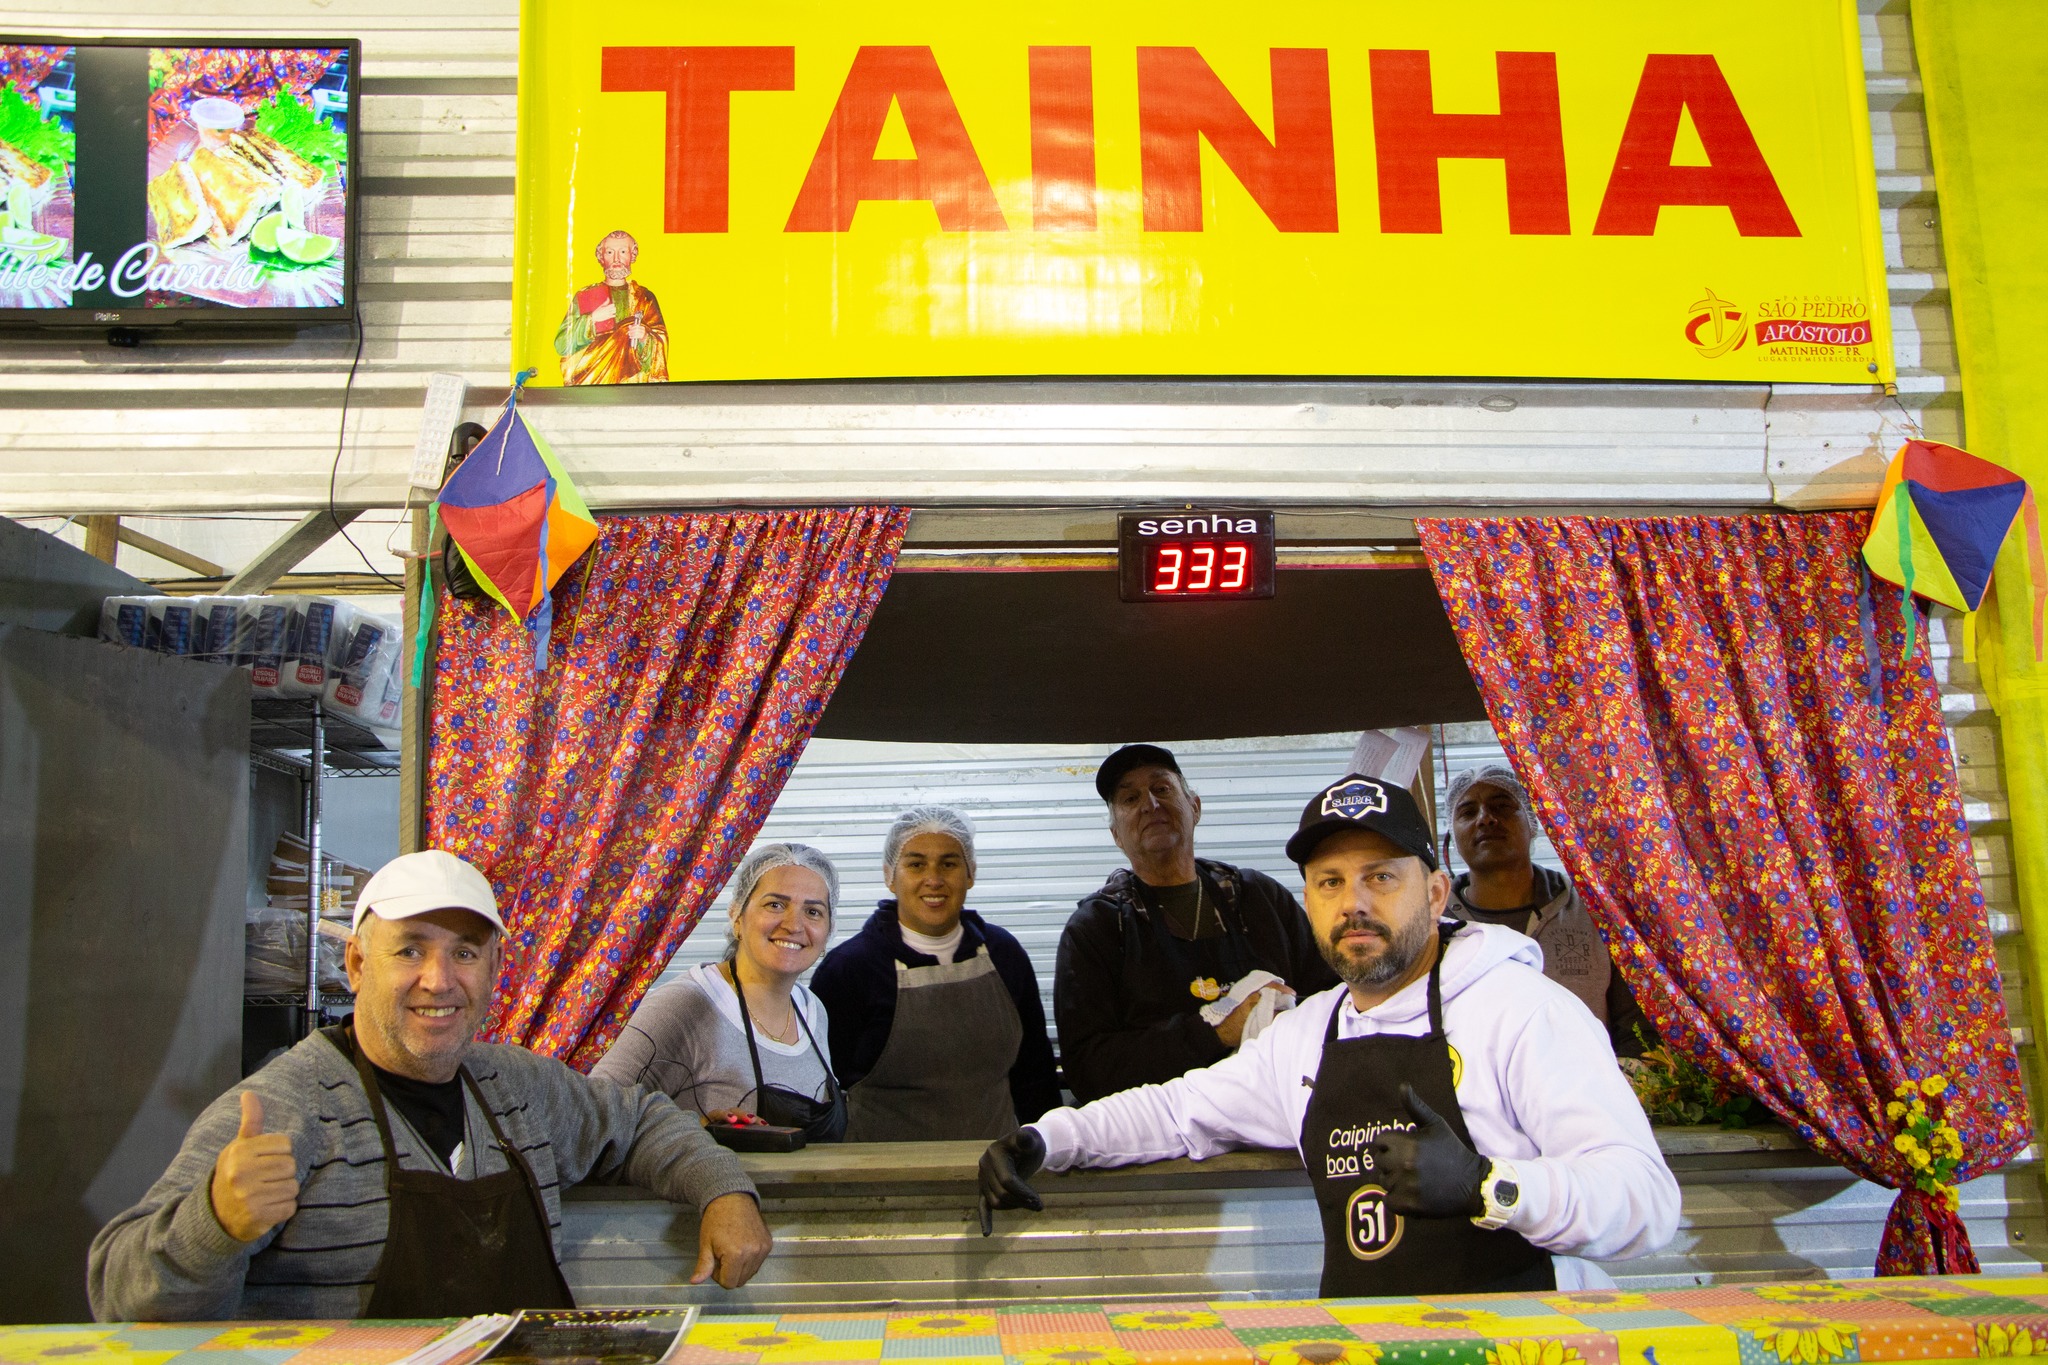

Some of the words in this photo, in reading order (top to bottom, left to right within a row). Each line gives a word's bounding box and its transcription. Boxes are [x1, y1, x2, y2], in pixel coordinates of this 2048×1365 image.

[600, 45, 1803, 238] TAINHA
[57, 251, 106, 291] de
[110, 241, 267, 298] Cavala
[1758, 299, 1796, 318] SÃO
[1801, 302, 1867, 318] PEDRO
[1762, 321, 1866, 344] APÓSTOLO
[1770, 346, 1835, 356] MATINHOS
[1846, 347, 1861, 356] PR
[1138, 514, 1258, 536] senha
[1155, 546, 1247, 591] 333
[298, 672, 322, 683] Divina
[300, 667, 322, 675] mesa
[1326, 1154, 1359, 1175] boa
[1362, 1148, 1375, 1171] é
[1357, 1200, 1386, 1243] 51
